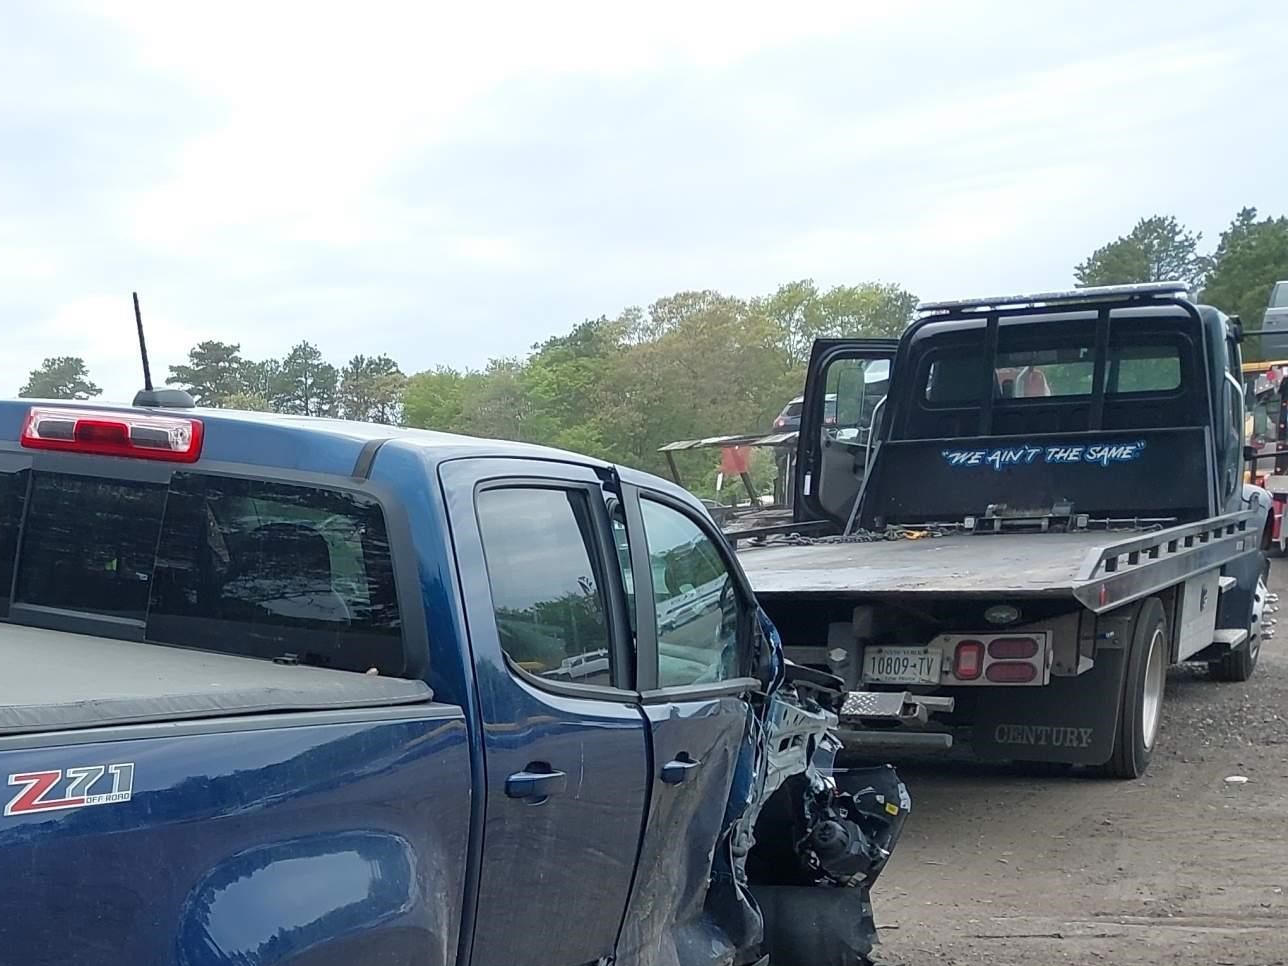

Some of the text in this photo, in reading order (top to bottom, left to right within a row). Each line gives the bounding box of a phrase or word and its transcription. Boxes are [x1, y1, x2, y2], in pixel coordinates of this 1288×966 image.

[987, 445, 1040, 470] AIN'T
[1047, 447, 1084, 462] THE
[995, 723, 1094, 748] CENTURY
[4, 762, 135, 816] Z71
[105, 792, 130, 802] ROAD
